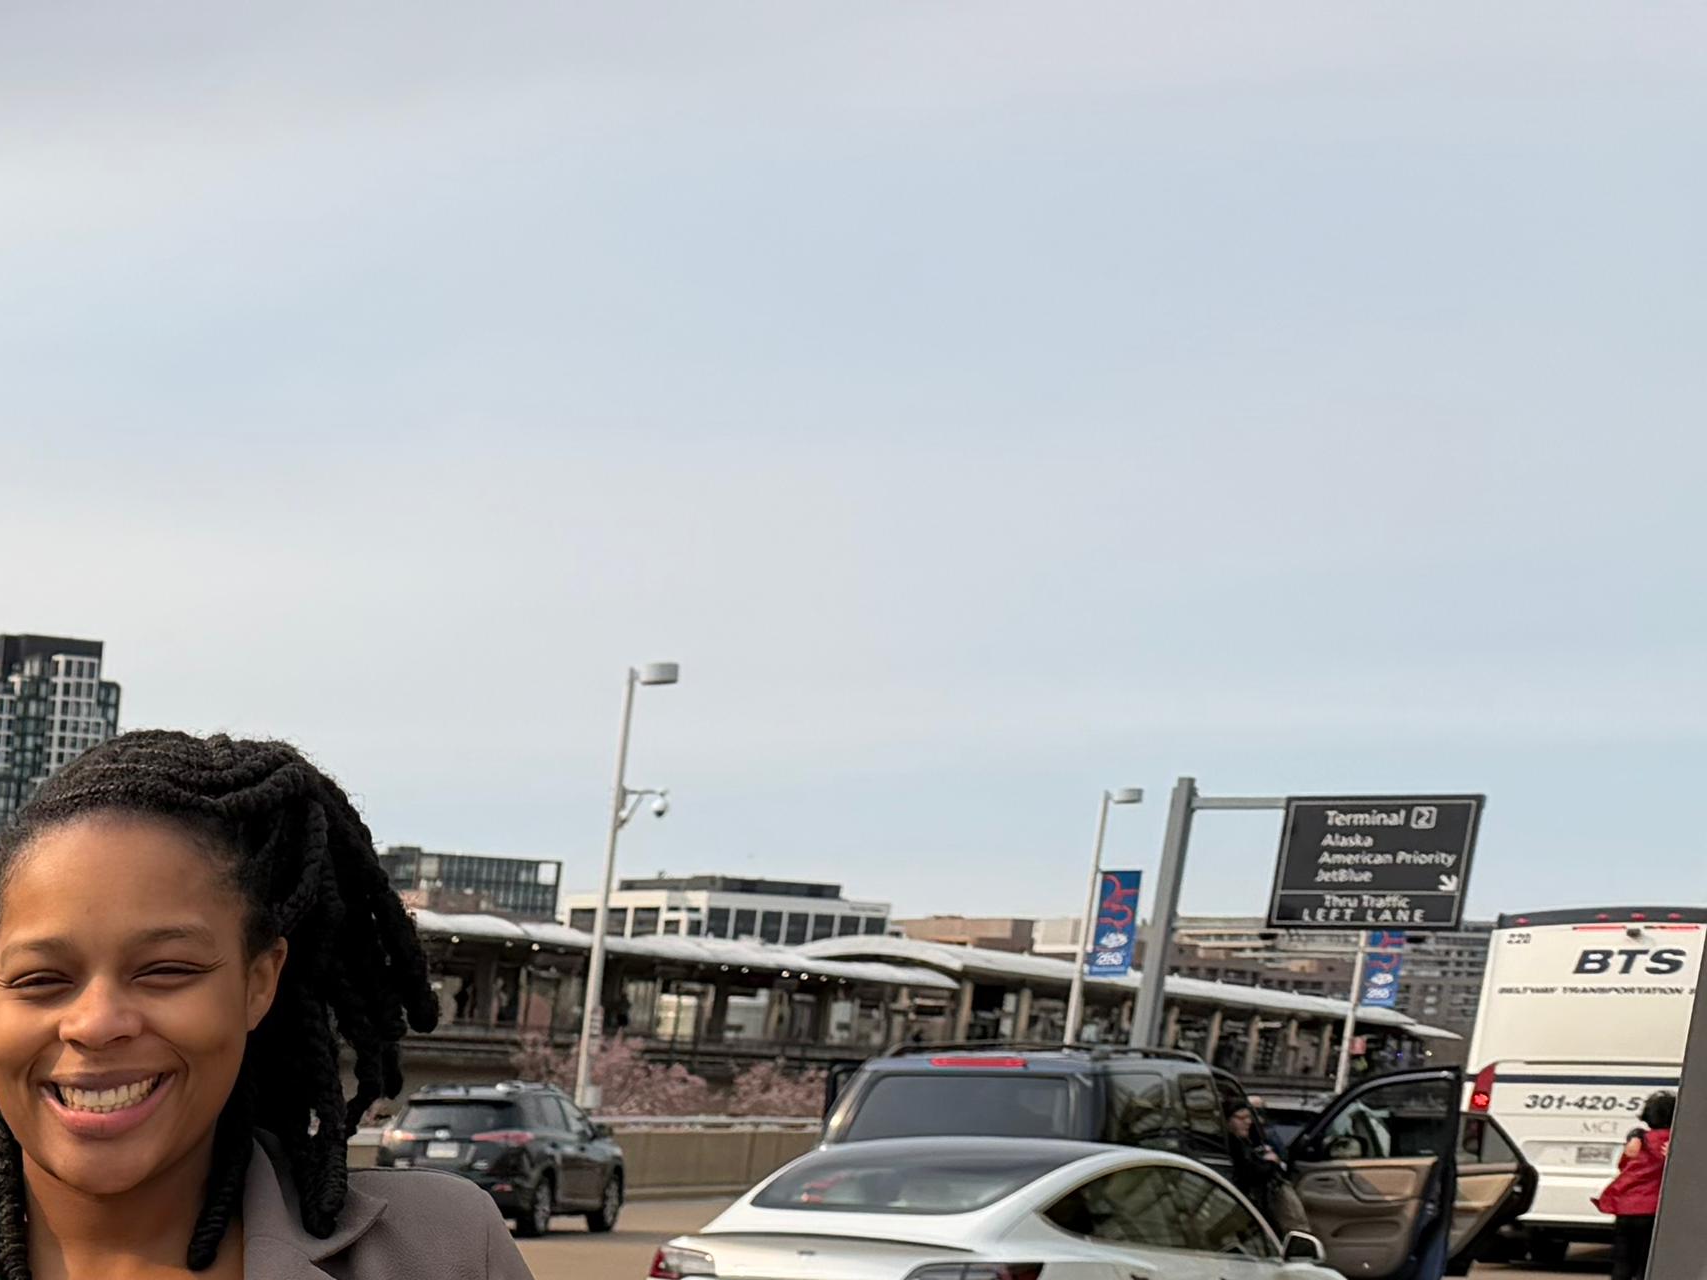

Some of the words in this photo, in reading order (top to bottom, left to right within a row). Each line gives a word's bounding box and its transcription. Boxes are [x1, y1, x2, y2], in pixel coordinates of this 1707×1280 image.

[1325, 809, 1405, 826] Terminal
[1321, 834, 1374, 847] Alaska
[1318, 852, 1393, 865] American
[1396, 851, 1456, 868] Priority
[1315, 869, 1373, 882] JetBlue
[1323, 895, 1359, 908] Thru
[1362, 895, 1410, 908] Traffic
[1302, 909, 1354, 922] LEFT
[1366, 909, 1426, 922] LANE
[1573, 949, 1687, 975] BTS
